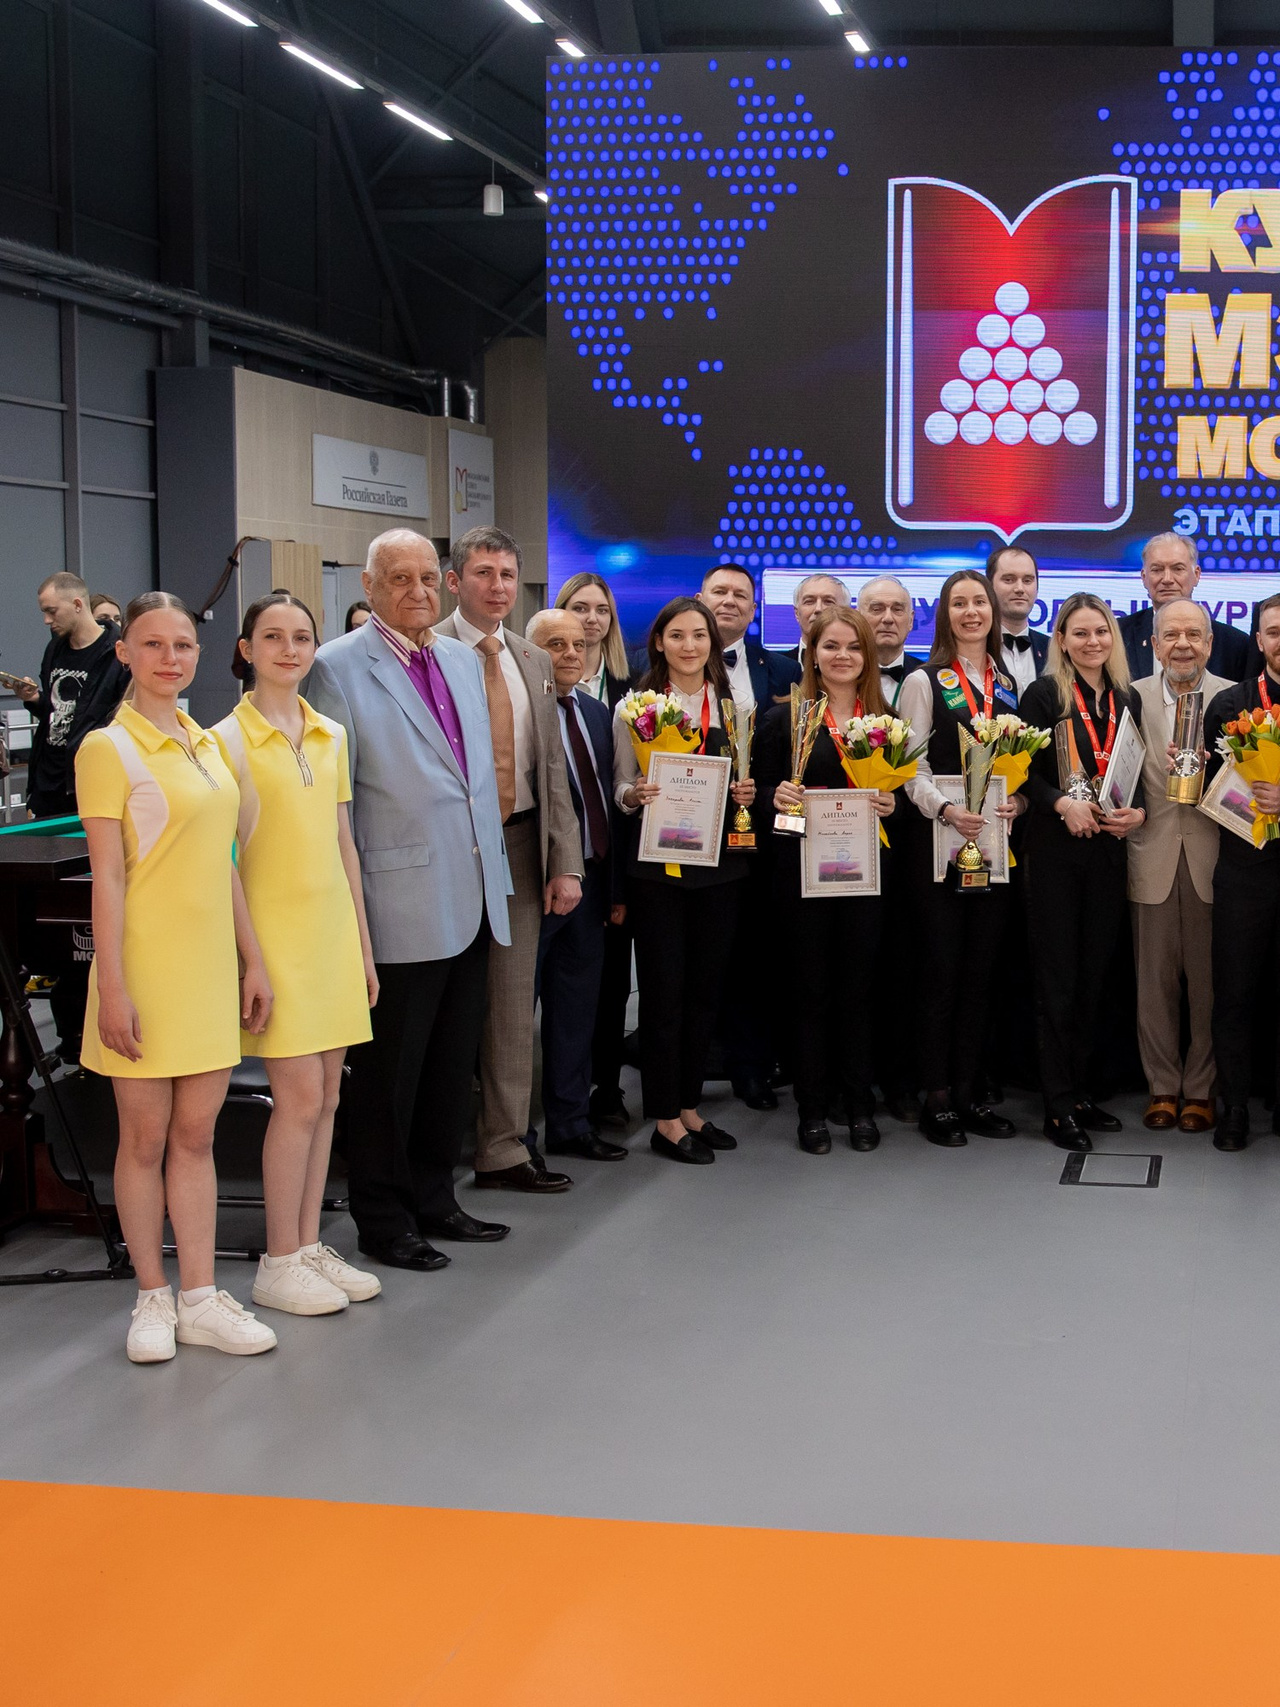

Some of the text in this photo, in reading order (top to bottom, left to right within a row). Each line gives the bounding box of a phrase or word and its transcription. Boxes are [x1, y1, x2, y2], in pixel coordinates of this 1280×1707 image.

[342, 484, 408, 507] Российская Газета
[1172, 509, 1280, 537] ЭТАП
[669, 777, 707, 786] ДИПЛОМ
[820, 811, 858, 819] ДИПЛОМ
